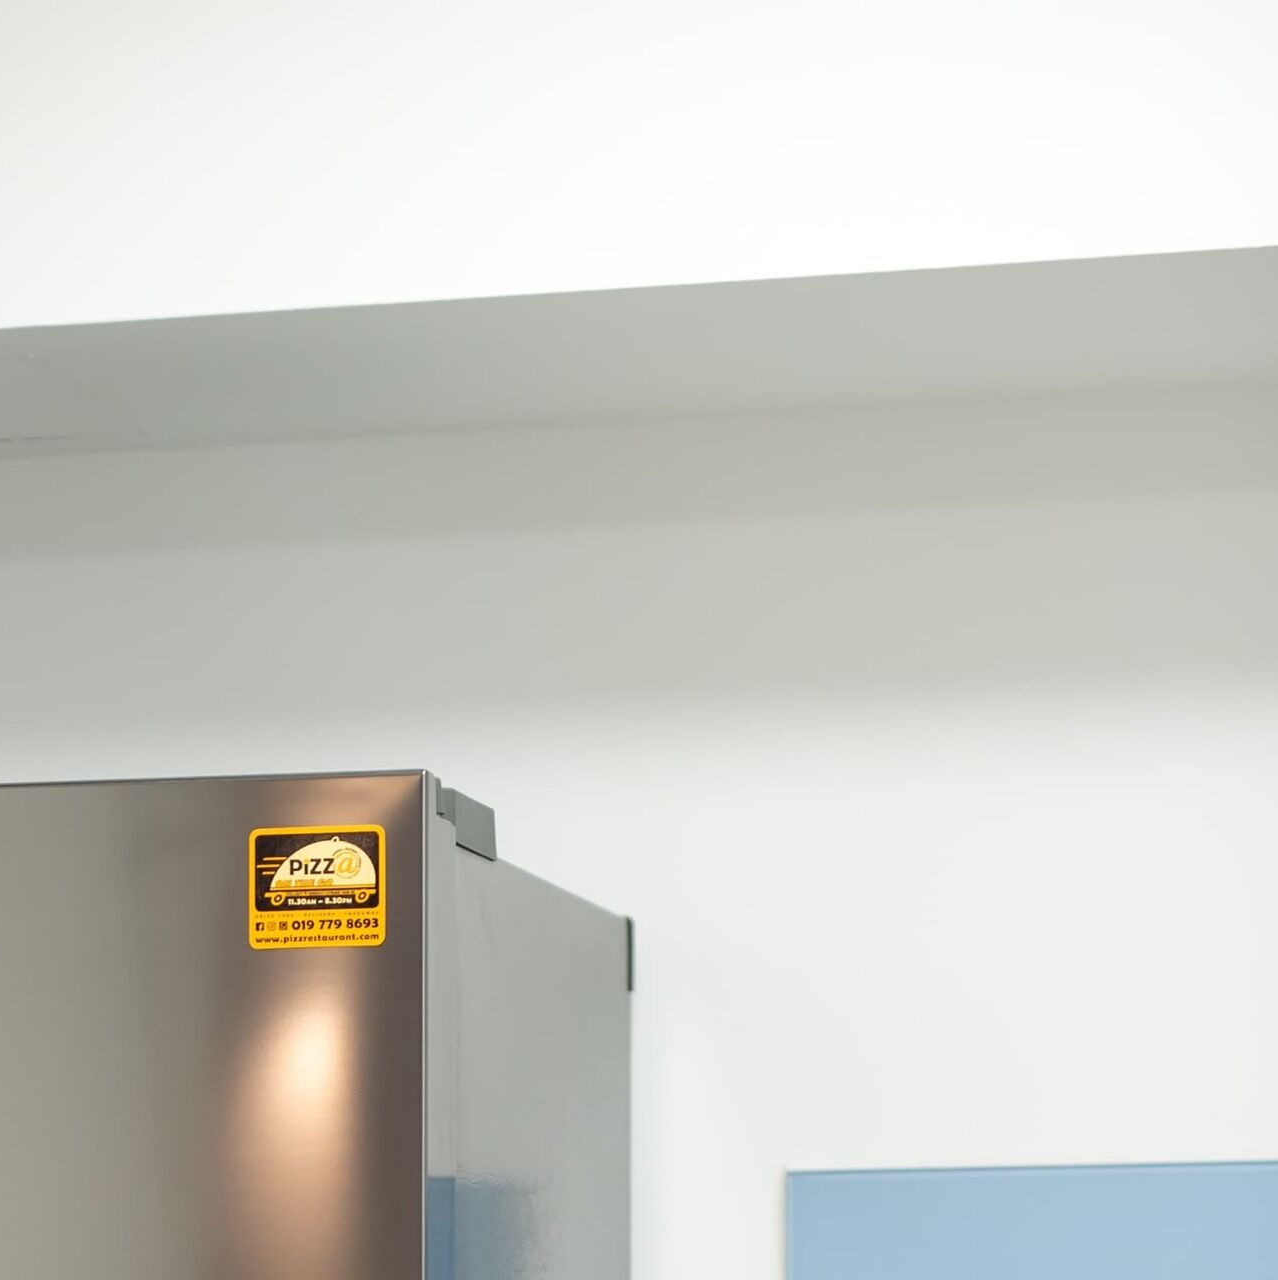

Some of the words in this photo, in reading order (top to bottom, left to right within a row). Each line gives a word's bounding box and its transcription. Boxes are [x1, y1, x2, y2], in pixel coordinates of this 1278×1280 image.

[291, 919, 315, 931] 019
[319, 919, 342, 930] 779
[346, 917, 379, 929] 8693
[255, 933, 380, 944] www.pizzrestaurant.com
